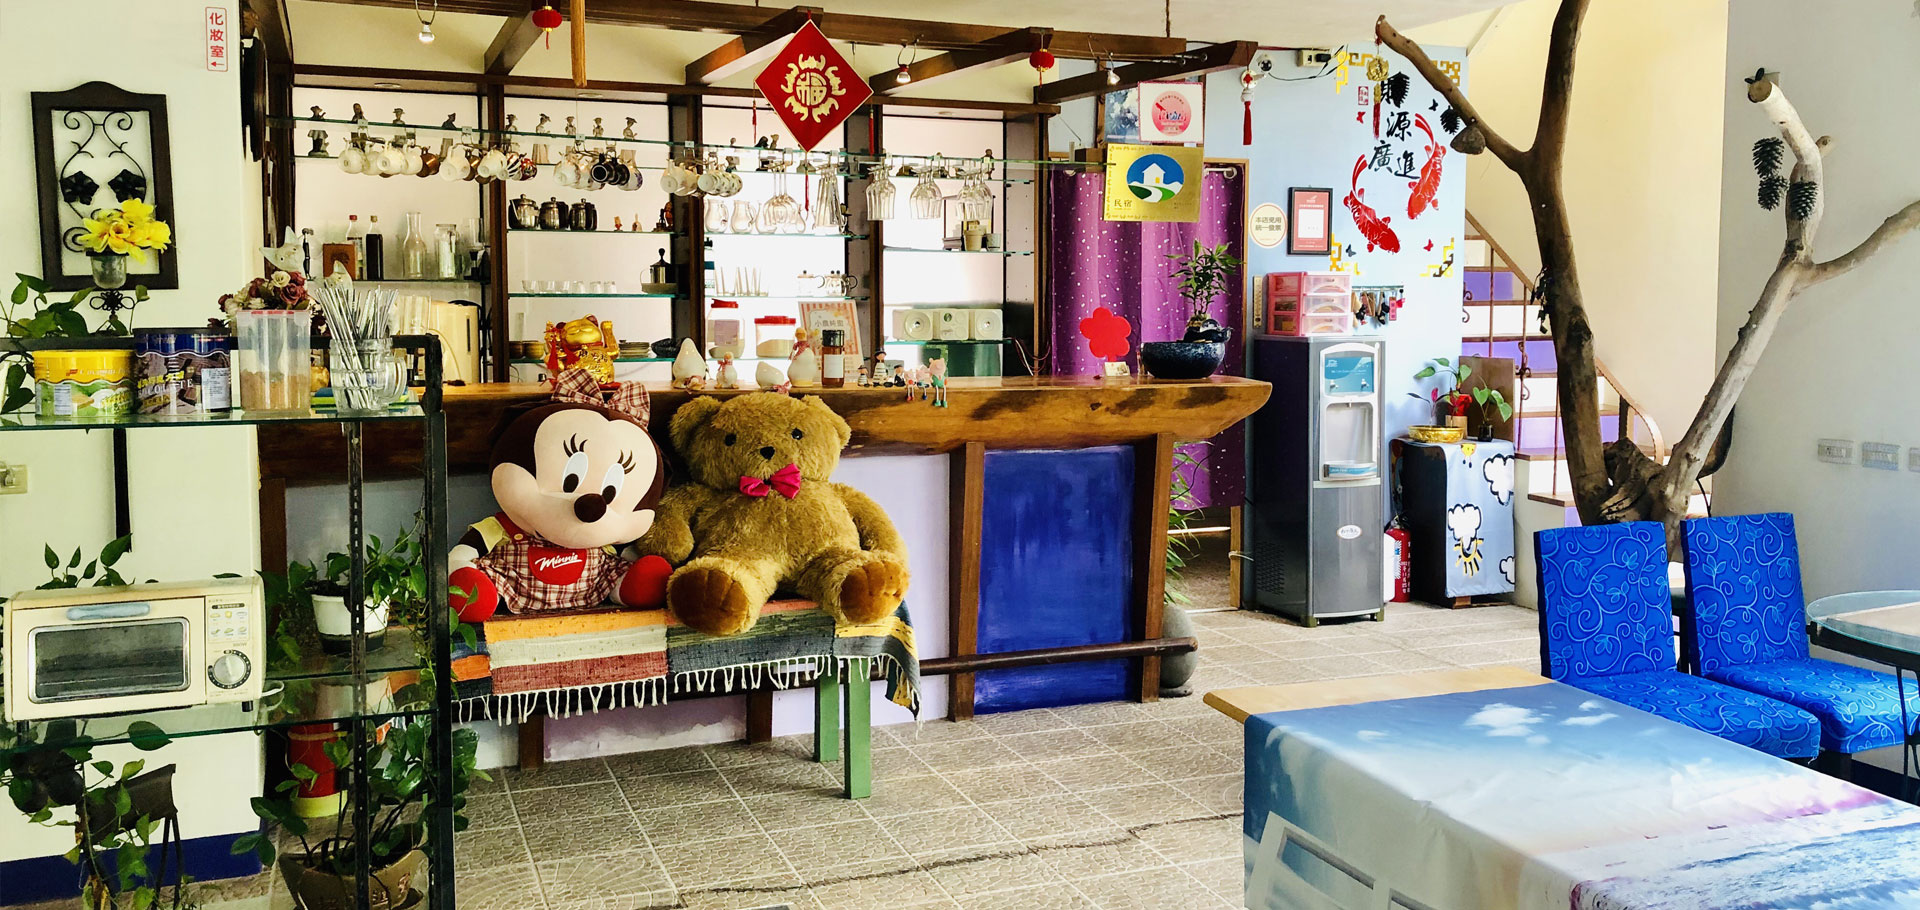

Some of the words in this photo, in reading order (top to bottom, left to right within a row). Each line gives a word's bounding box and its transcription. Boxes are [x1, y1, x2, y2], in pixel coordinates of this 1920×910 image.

[209, 12, 224, 58] 化妝室
[796, 72, 827, 106] 福
[1114, 199, 1132, 208] 民宿
[534, 552, 583, 572] Minnie
